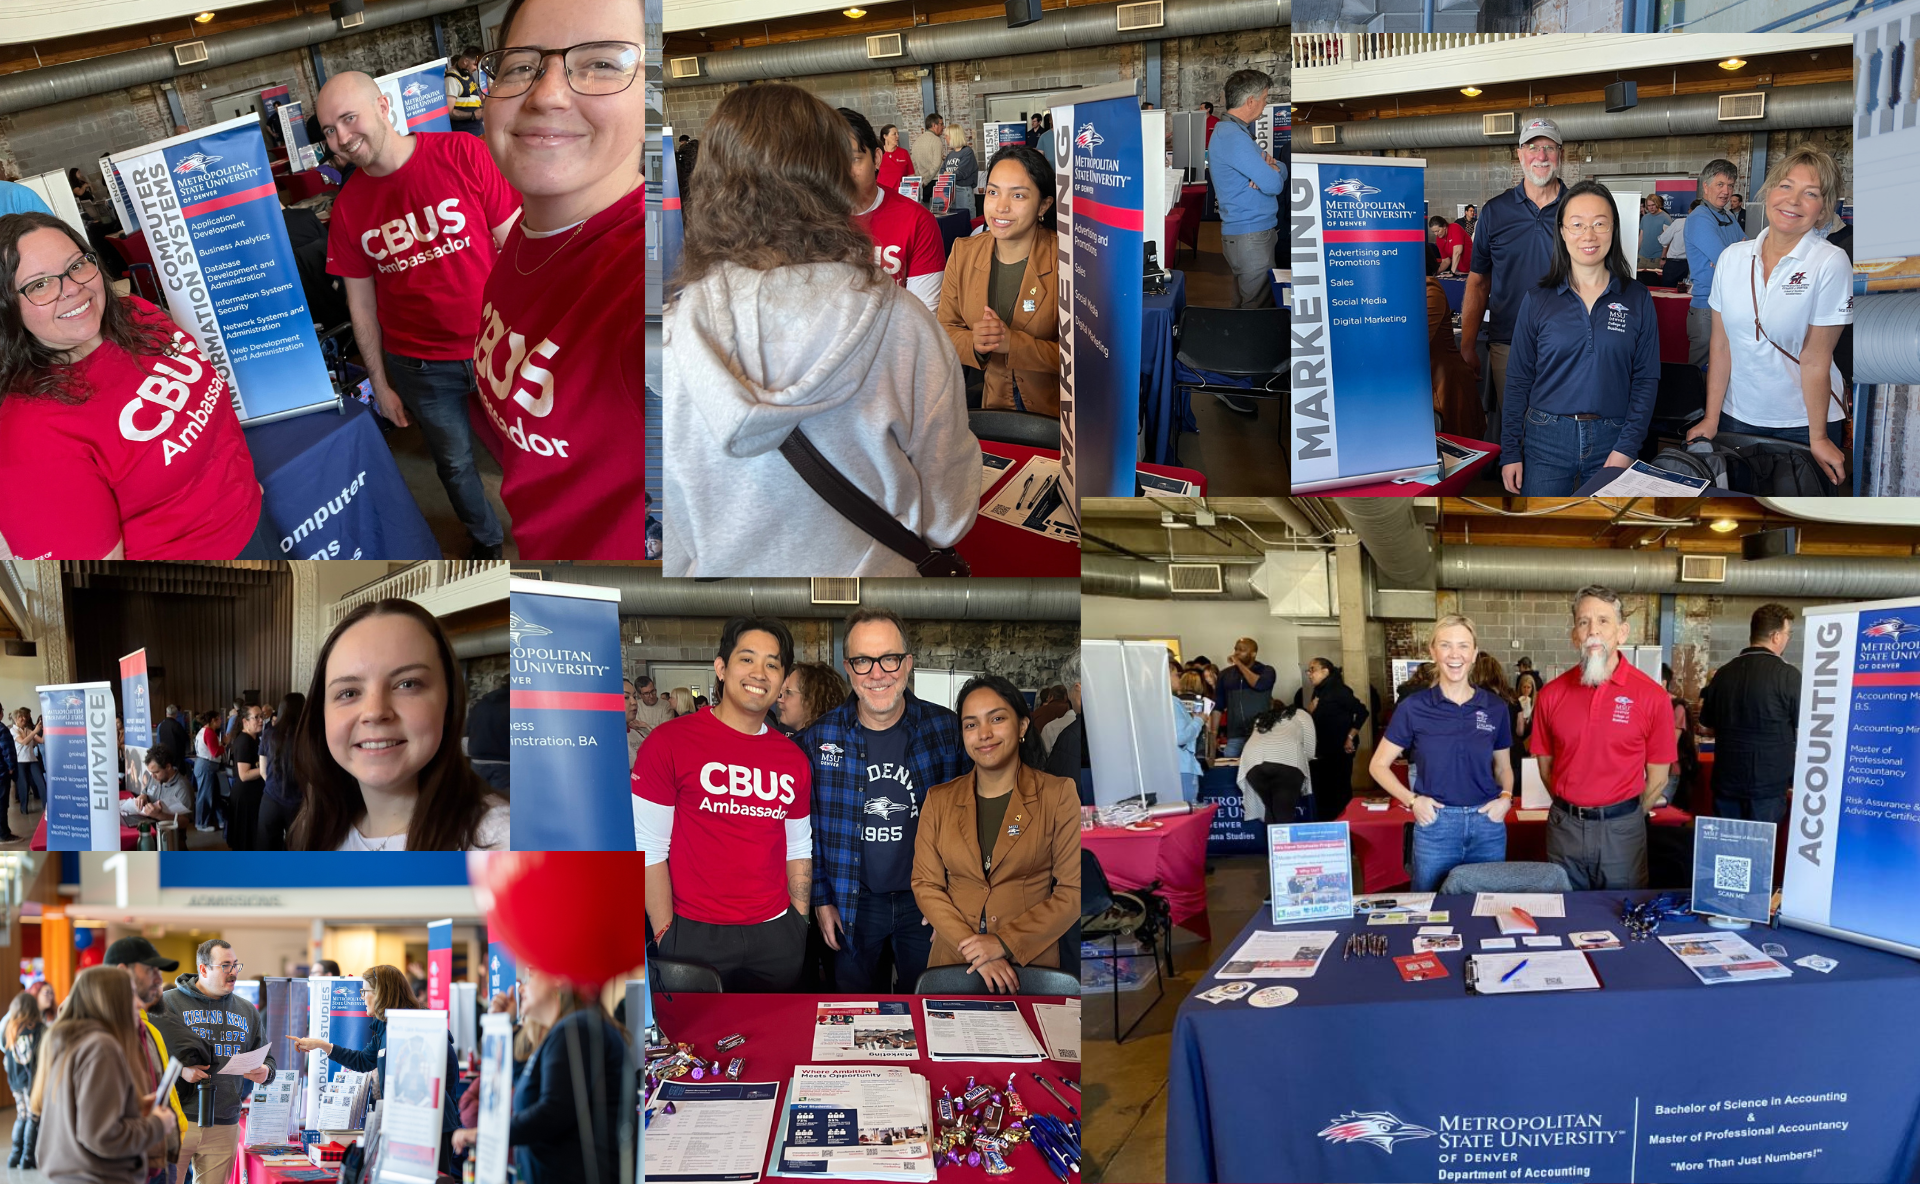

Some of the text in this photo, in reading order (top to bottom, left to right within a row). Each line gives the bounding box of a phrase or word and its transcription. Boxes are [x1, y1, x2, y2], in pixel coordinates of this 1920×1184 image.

[404, 90, 440, 106] METROPOLITAN
[406, 103, 419, 111] STATE
[1074, 155, 1120, 172] METROPOLITAN
[102, 161, 122, 203] ENGLISH
[177, 162, 250, 188] METROPOLITAN
[1074, 168, 1090, 180] STATE
[180, 184, 206, 196] STATE
[194, 190, 218, 200] DENVER
[1326, 200, 1406, 210] METROPOLITAN
[192, 213, 236, 230] Application
[1326, 210, 1354, 218] STATE
[132, 168, 183, 292] COMPUTER
[194, 220, 246, 239] Development
[361, 198, 466, 260] CBUS
[1074, 222, 1108, 246] Advertising and
[200, 233, 270, 256] Business Analytics
[1074, 236, 1098, 256] Promotions
[1329, 248, 1380, 258] Advertising
[378, 236, 471, 274] Ambassador
[1330, 258, 1380, 266] Promotions
[204, 259, 240, 274] Database
[207, 259, 275, 282] Development and
[1074, 262, 1086, 278] Sales
[149, 163, 242, 411] INORMATION SYSTEMS
[210, 272, 266, 290] Administration
[1330, 278, 1354, 286] Sales
[216, 282, 292, 308] Information Systems
[1332, 296, 1387, 306] Social Media
[218, 303, 248, 316] Security
[1056, 125, 1074, 487] MARKETING
[1074, 290, 1098, 318] Social Media
[223, 305, 304, 332] Network Systems and
[1291, 178, 1332, 460] MARKETING
[1334, 314, 1406, 326] Digital Marketing
[226, 322, 280, 340] Administration
[1075, 316, 1109, 358] Digital Marketing
[230, 334, 300, 356] Web Development
[234, 342, 304, 364] and Administration
[474, 302, 560, 418] BUS
[162, 366, 227, 466] Ambassad
[280, 470, 366, 553] omputer
[510, 648, 592, 662] OPOLITAN
[1862, 642, 1920, 652] METROPOL
[1860, 652, 1888, 661] STATE
[1856, 692, 1907, 701] Accounting
[1853, 724, 1904, 734] Accounting
[579, 736, 598, 746] BA
[1798, 622, 1842, 867] ACCOUNTING
[821, 753, 840, 762] MSU
[1850, 756, 1902, 766] Professional
[1849, 766, 1906, 778] Accountancy
[700, 762, 795, 804] CBUS
[1848, 776, 1884, 786] (MPAcc)
[700, 796, 788, 820] Ambassado
[1846, 796, 1864, 804] Risk
[1866, 798, 1911, 810] Assurance
[1844, 806, 1920, 822] Advisory Certifica
[1226, 832, 1255, 840] Studies
[102, 852, 128, 908] 1
[183, 1010, 222, 1026] KISLING
[321, 986, 330, 1038] STUDIES
[192, 1027, 246, 1042] EST. 1975
[1655, 1092, 1848, 1114] Bachelor of Science in Accounting
[1439, 1114, 1602, 1132] METROPOLITAN
[1746, 1113, 1756, 1122] &
[1439, 1133, 1494, 1148] STATE
[1650, 1120, 1848, 1144] Master of Professional Accountancy
[1439, 1153, 1518, 1162] OF DENVER
[1671, 1149, 1822, 1172] "More Than Just Numbers!"
[1438, 1166, 1590, 1182] Department of Accounting
